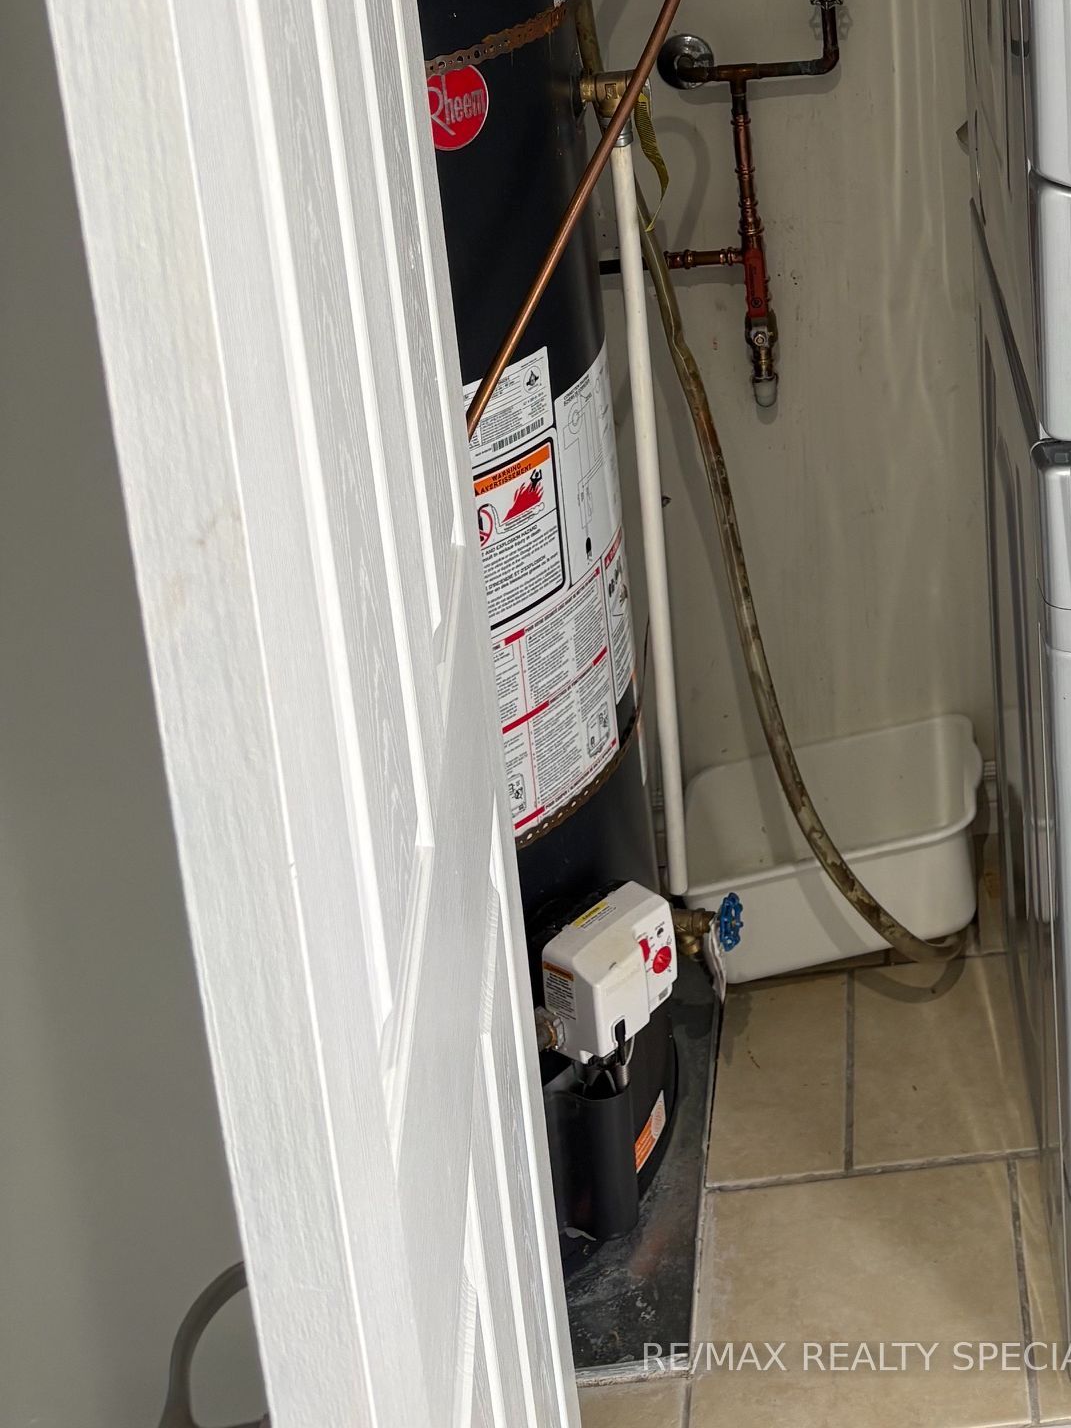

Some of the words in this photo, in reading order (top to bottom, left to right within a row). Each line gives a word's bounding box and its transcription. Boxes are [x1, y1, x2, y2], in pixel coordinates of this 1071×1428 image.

[428, 74, 485, 135] Rheem
[480, 464, 532, 494] AVERTISSEMENT
[491, 463, 521, 481] WARNING
